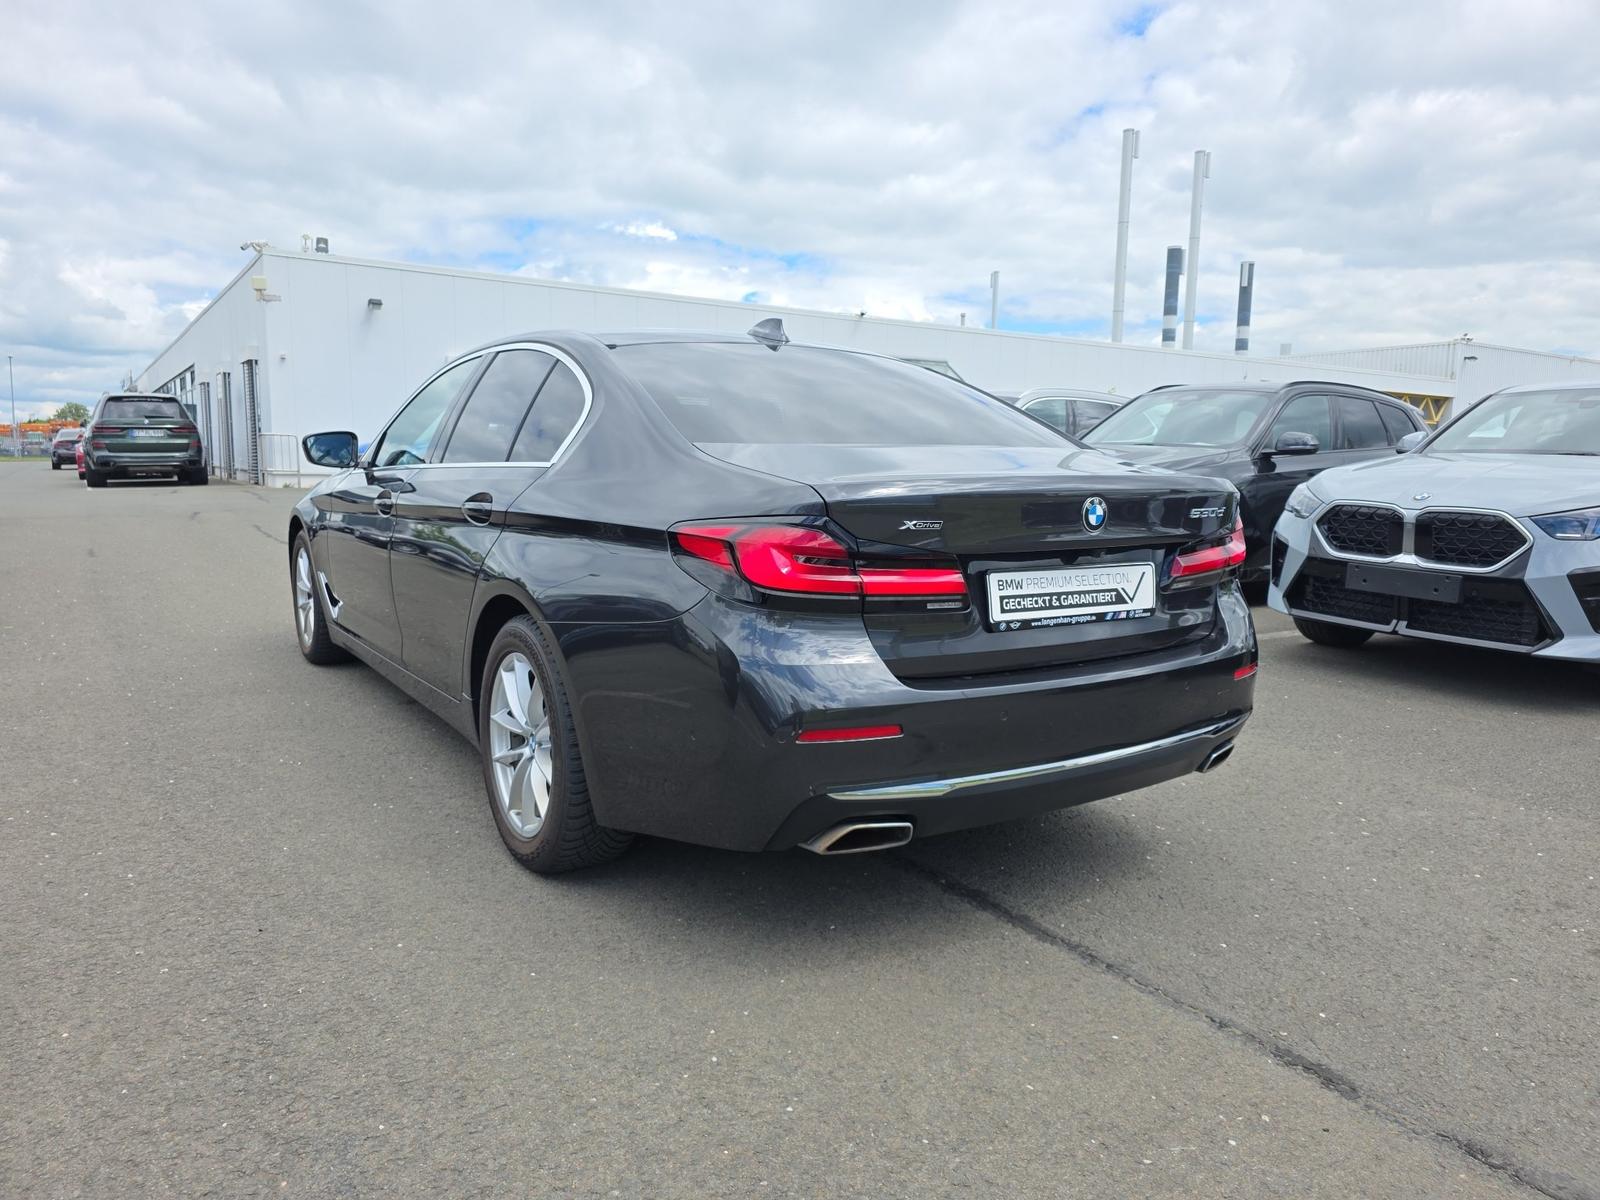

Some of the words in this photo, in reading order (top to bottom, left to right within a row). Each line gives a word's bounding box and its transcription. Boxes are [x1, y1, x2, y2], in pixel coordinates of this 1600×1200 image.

[997, 578, 1023, 591] BMW
[1026, 575, 1073, 589] PREMIUM
[1003, 596, 1050, 610] GECHECKT
[1052, 595, 1060, 606] &
[1061, 592, 1117, 605] GARANTIERT
